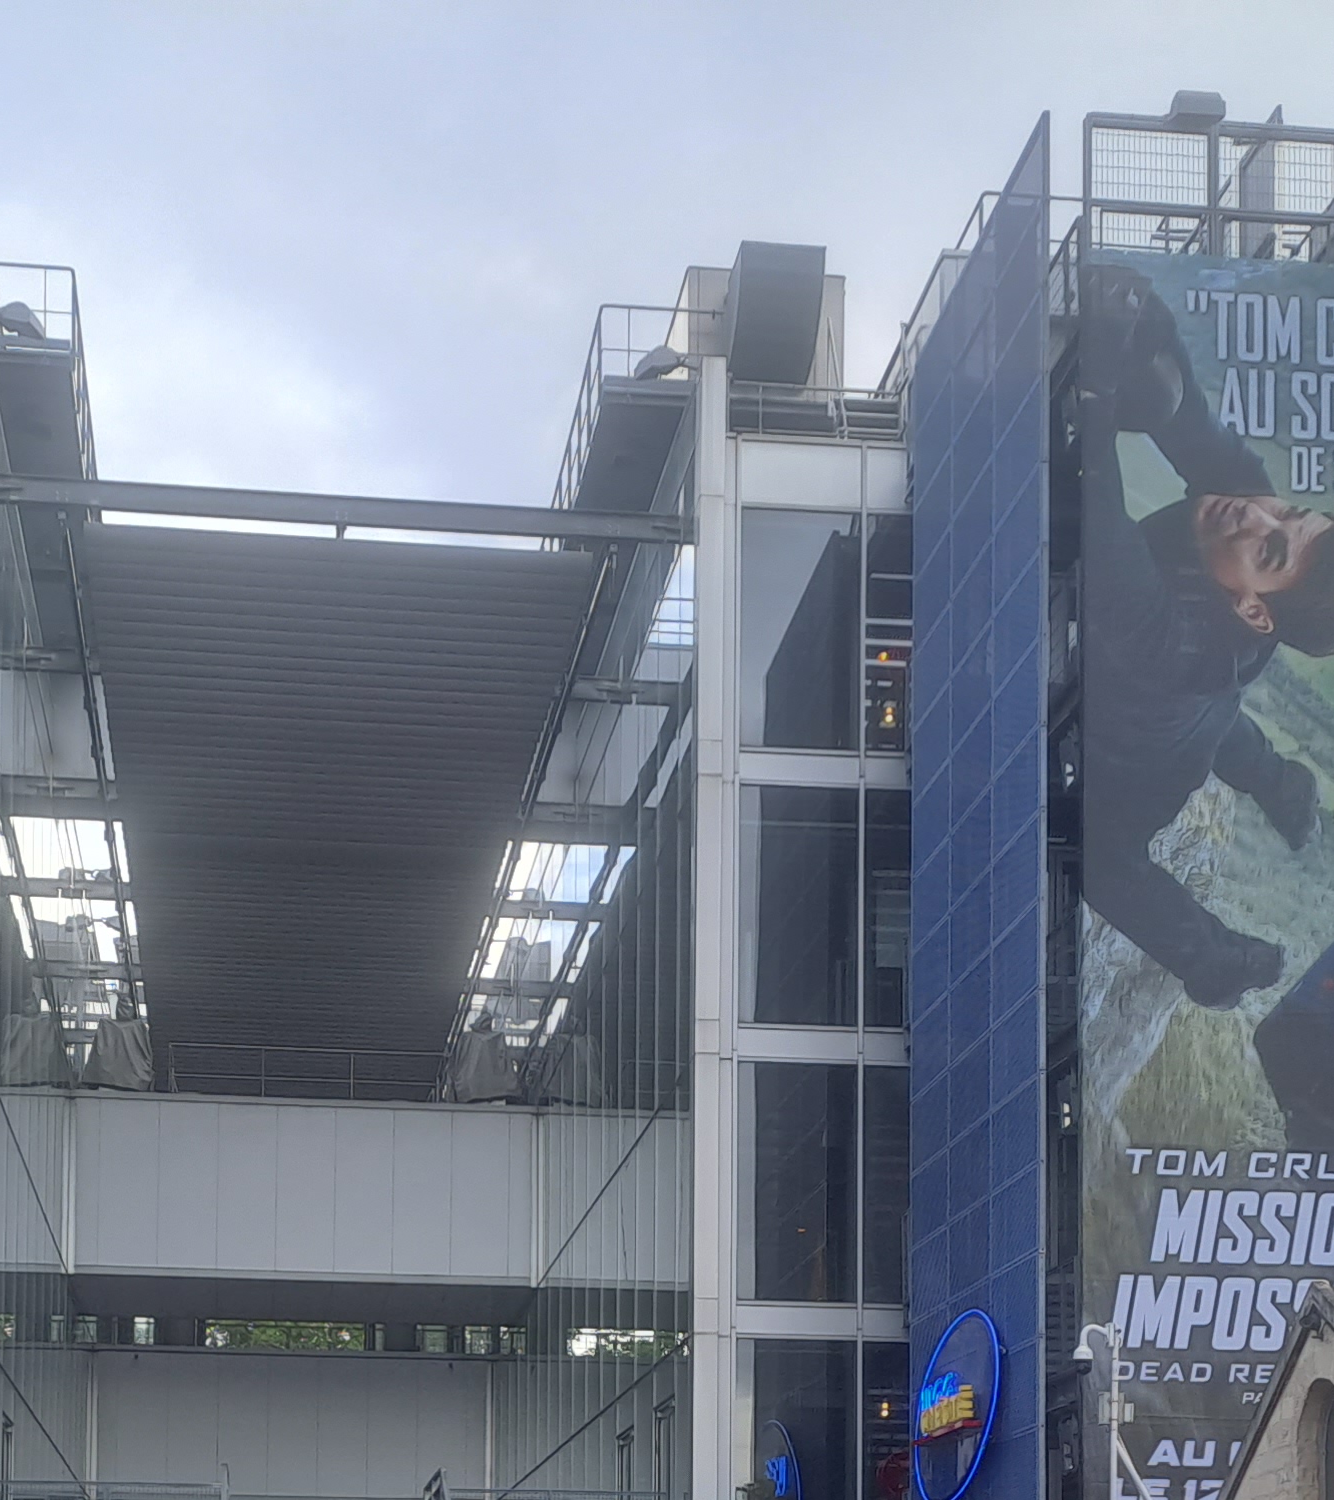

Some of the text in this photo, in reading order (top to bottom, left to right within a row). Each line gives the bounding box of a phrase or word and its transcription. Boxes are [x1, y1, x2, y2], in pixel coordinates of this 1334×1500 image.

[1186, 289, 1301, 365] "TOM
[1219, 366, 1276, 438] AU
[1290, 446, 1325, 492] DE
[1125, 1148, 1227, 1177] TOM
[1115, 1361, 1212, 1382] DEAD
[1147, 1439, 1216, 1467] AU
